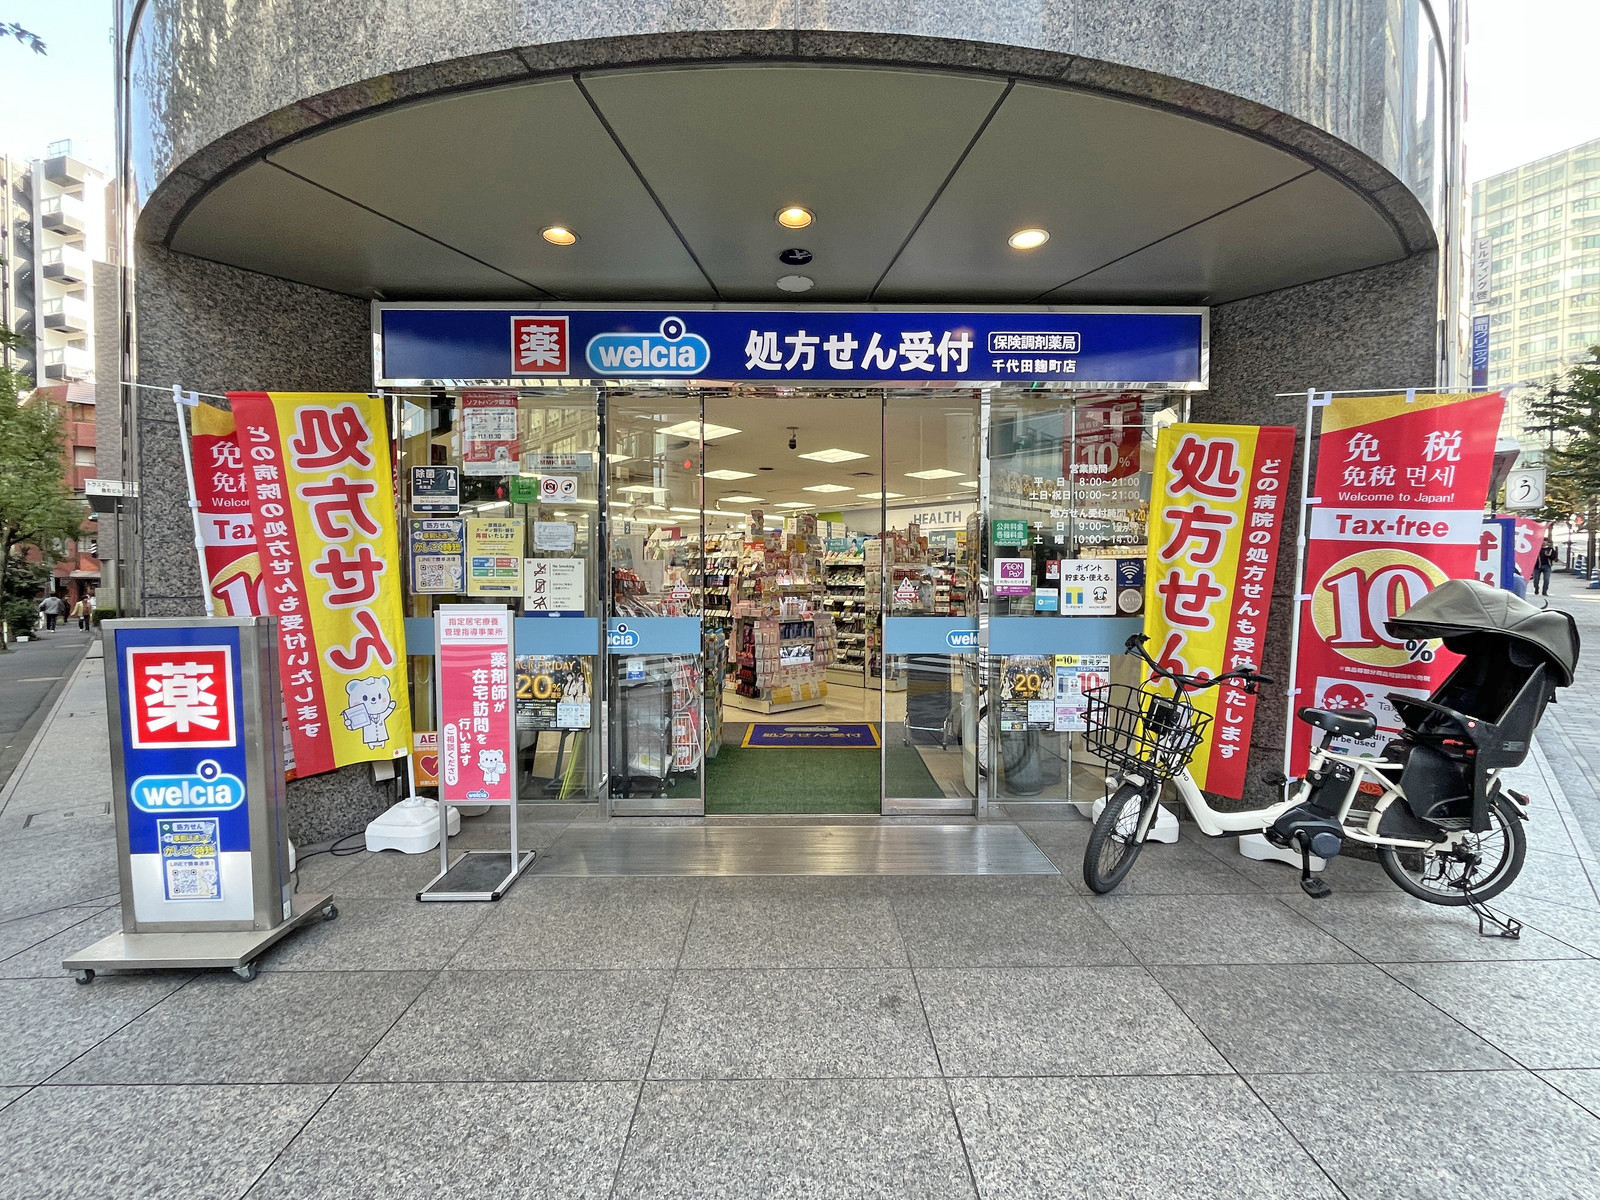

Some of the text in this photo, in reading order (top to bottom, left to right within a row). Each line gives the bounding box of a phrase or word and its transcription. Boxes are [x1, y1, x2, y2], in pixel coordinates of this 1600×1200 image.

[519, 323, 561, 367] 薬
[744, 329, 974, 374] 処方せん受付
[993, 335, 1076, 350] 保険調剤薬局
[599, 339, 696, 368] welcia
[1069, 464, 1108, 474] 営業時間
[1406, 465, 1456, 488] 면세
[415, 478, 436, 486] コート
[1519, 480, 1532, 501] う
[1338, 491, 1455, 504] Welcome to Japan!
[913, 511, 962, 524] HEALTH
[996, 522, 1025, 531] 公共料金
[1335, 514, 1450, 538] Tax-free
[996, 531, 1025, 539] 各種料金
[1149, 437, 1240, 692] 処方せん
[448, 617, 499, 626] 指定居宅療養
[1326, 567, 1435, 662] 10%
[444, 628, 503, 636] 管理指導事業所
[607, 632, 633, 645] lcia
[490, 651, 508, 713] 薬剤師が
[143, 661, 221, 733] 薬
[471, 668, 490, 745] 在宅訪問を
[420, 734, 438, 744] AE
[458, 717, 472, 767] 行います
[1354, 739, 1376, 748] used
[142, 780, 233, 807] welcia
[176, 823, 203, 831] 処方せん
